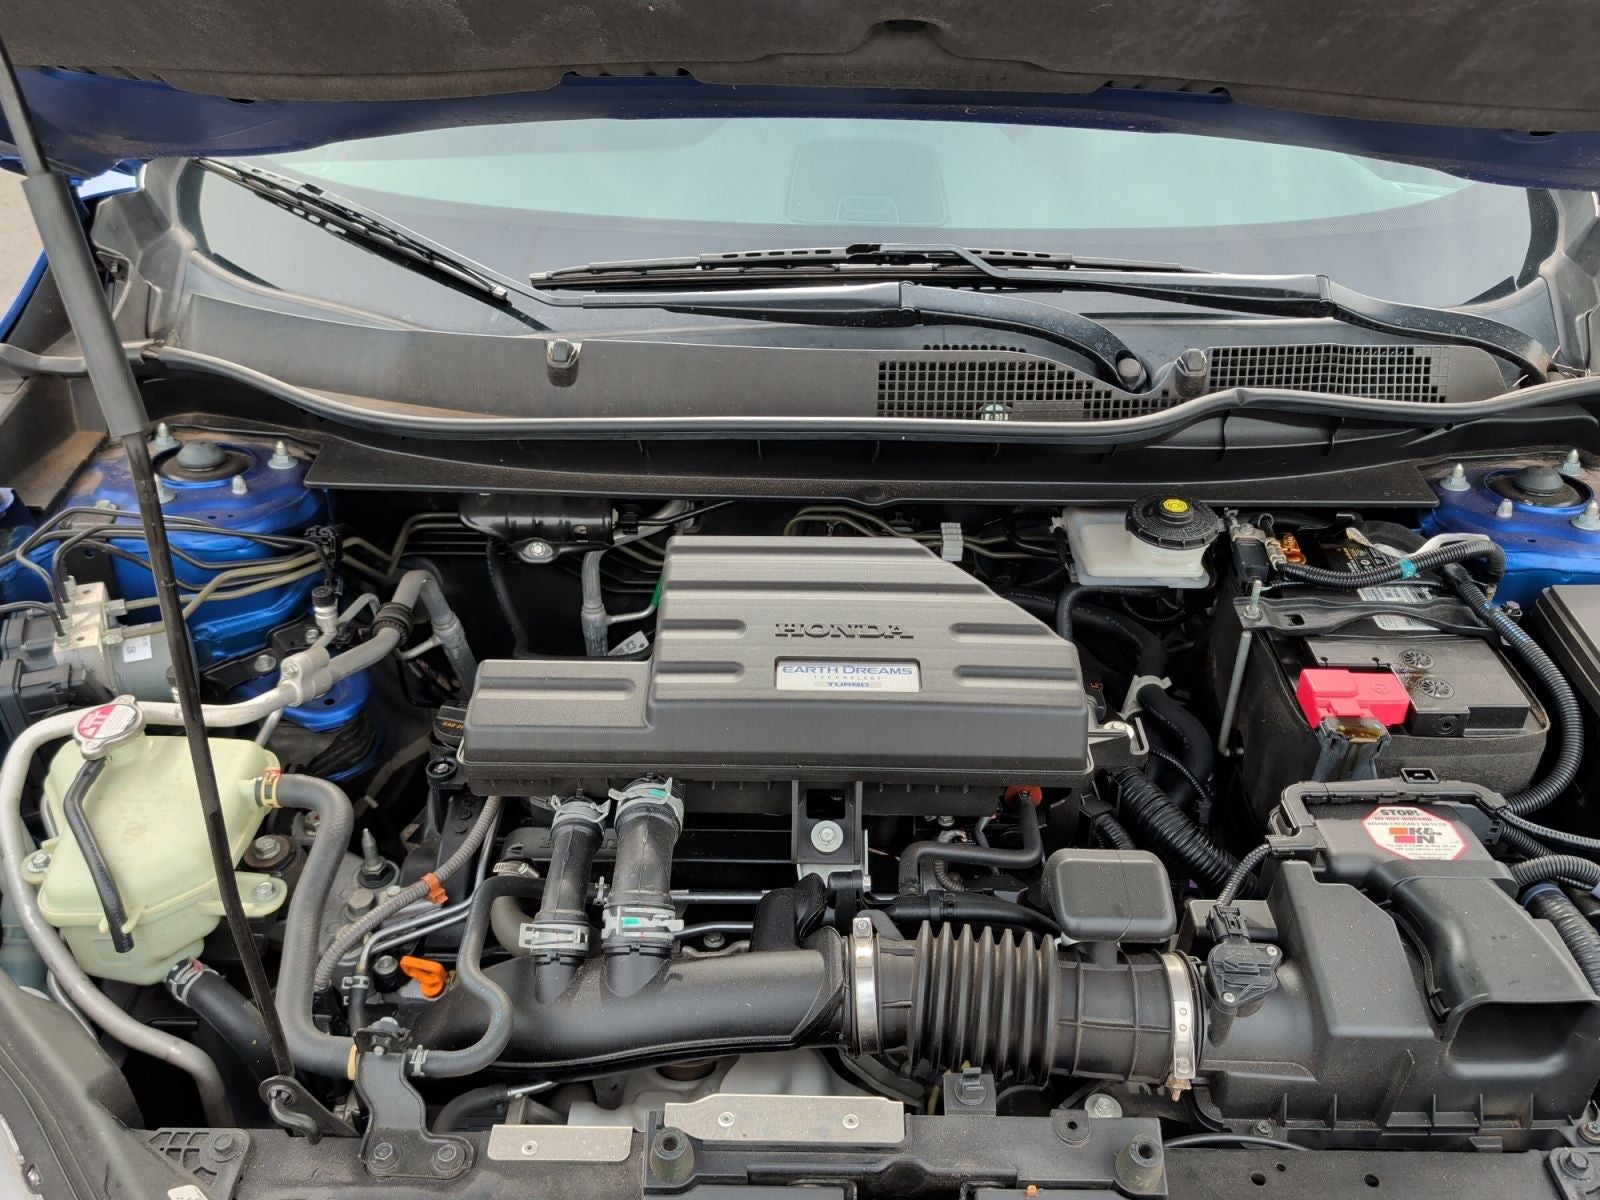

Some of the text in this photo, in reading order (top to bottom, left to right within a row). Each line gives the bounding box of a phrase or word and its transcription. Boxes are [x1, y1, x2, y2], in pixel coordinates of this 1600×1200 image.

[775, 623, 914, 639] HONDA
[782, 665, 912, 675] EARTH DREAMS
